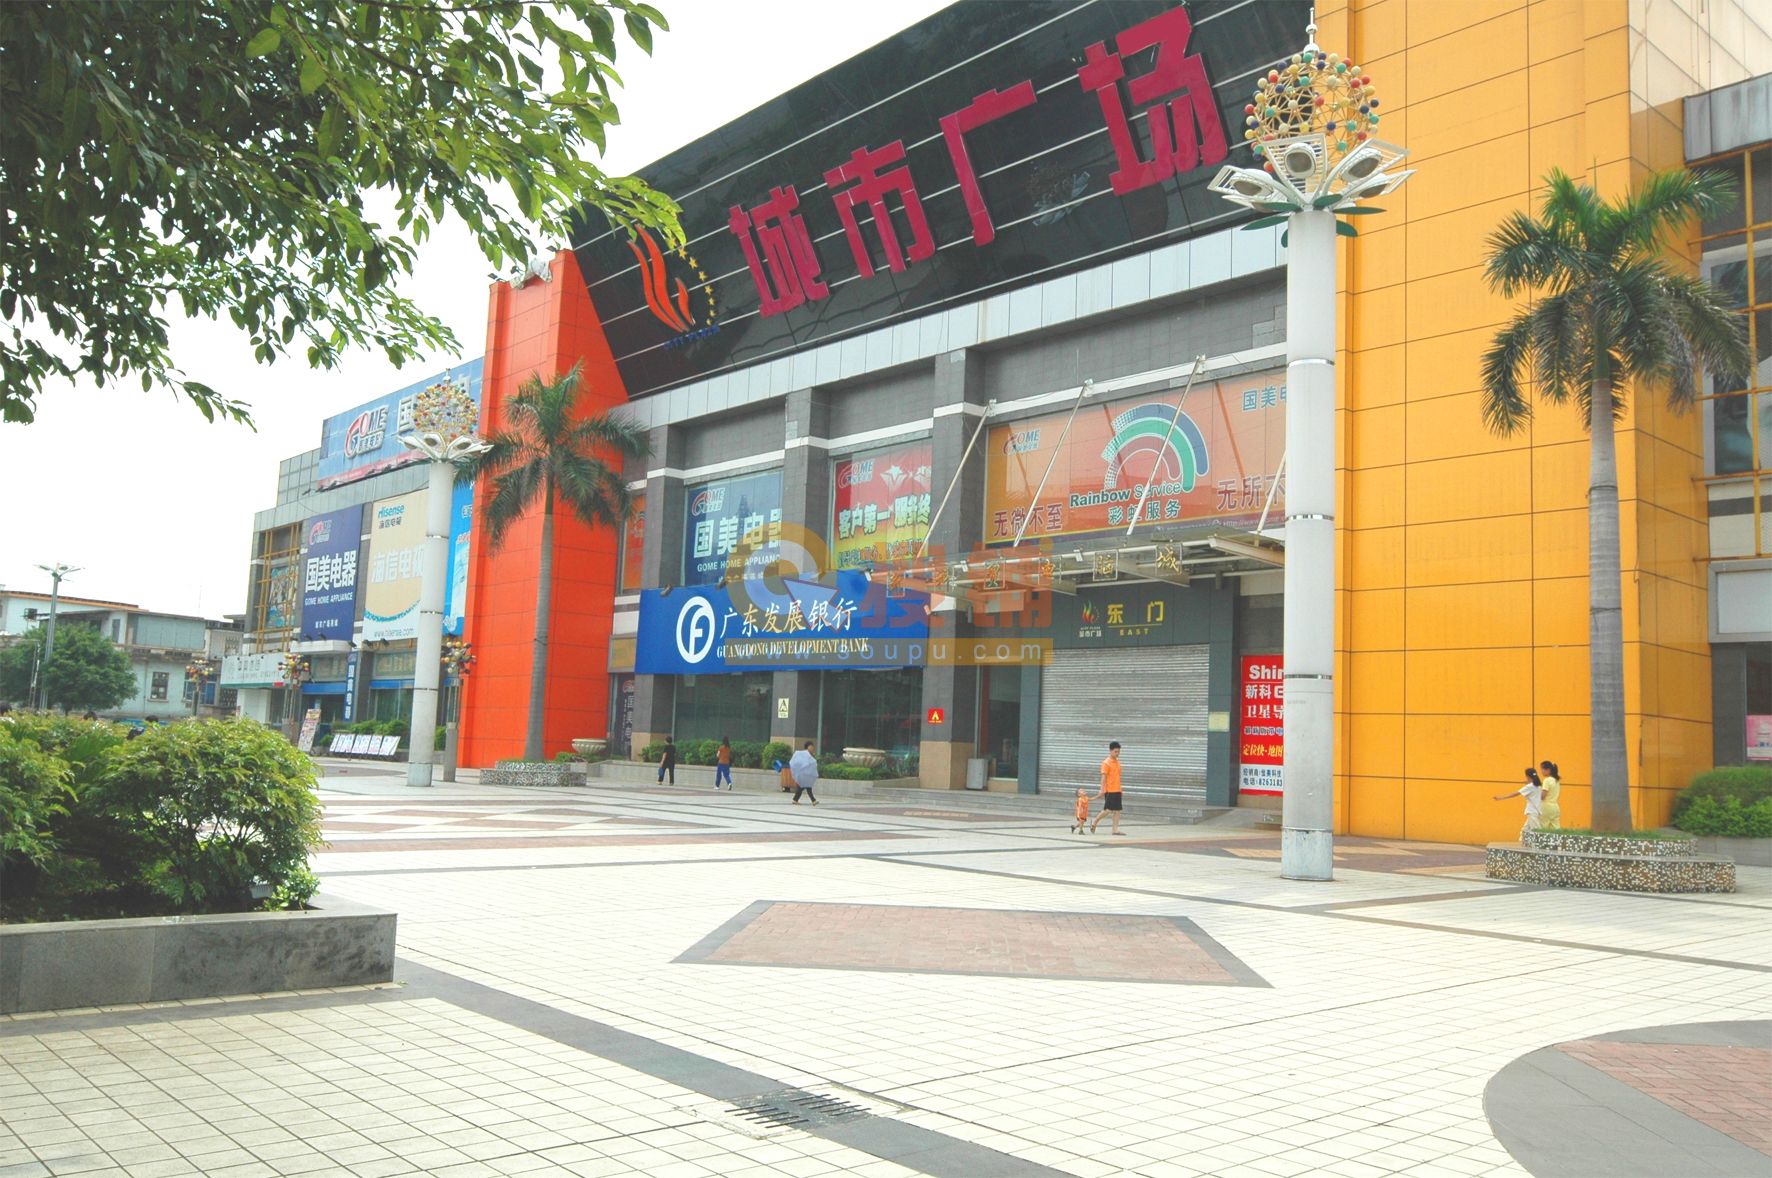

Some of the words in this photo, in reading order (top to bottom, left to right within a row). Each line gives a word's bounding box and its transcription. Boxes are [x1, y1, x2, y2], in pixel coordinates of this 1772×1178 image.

[727, 5, 1229, 318] 城市广场
[1070, 489, 1131, 508] Rainbow
[378, 504, 404, 518] Hisense
[838, 502, 891, 540] 客户第一
[993, 503, 1063, 537] 无微不至
[693, 508, 783, 559] 国美电器
[305, 550, 357, 593] 国美电器
[697, 561, 719, 572] GOME
[720, 558, 742, 569] HOME
[720, 597, 858, 639] 广东发展银行
[1107, 600, 1165, 624] 东门
[1119, 628, 1150, 637] EAST
[716, 642, 768, 658] GUANGDONG
[769, 639, 839, 656] DEVELOPMENT
[840, 637, 869, 653] BANK
[1245, 704, 1284, 720] 卫星导
